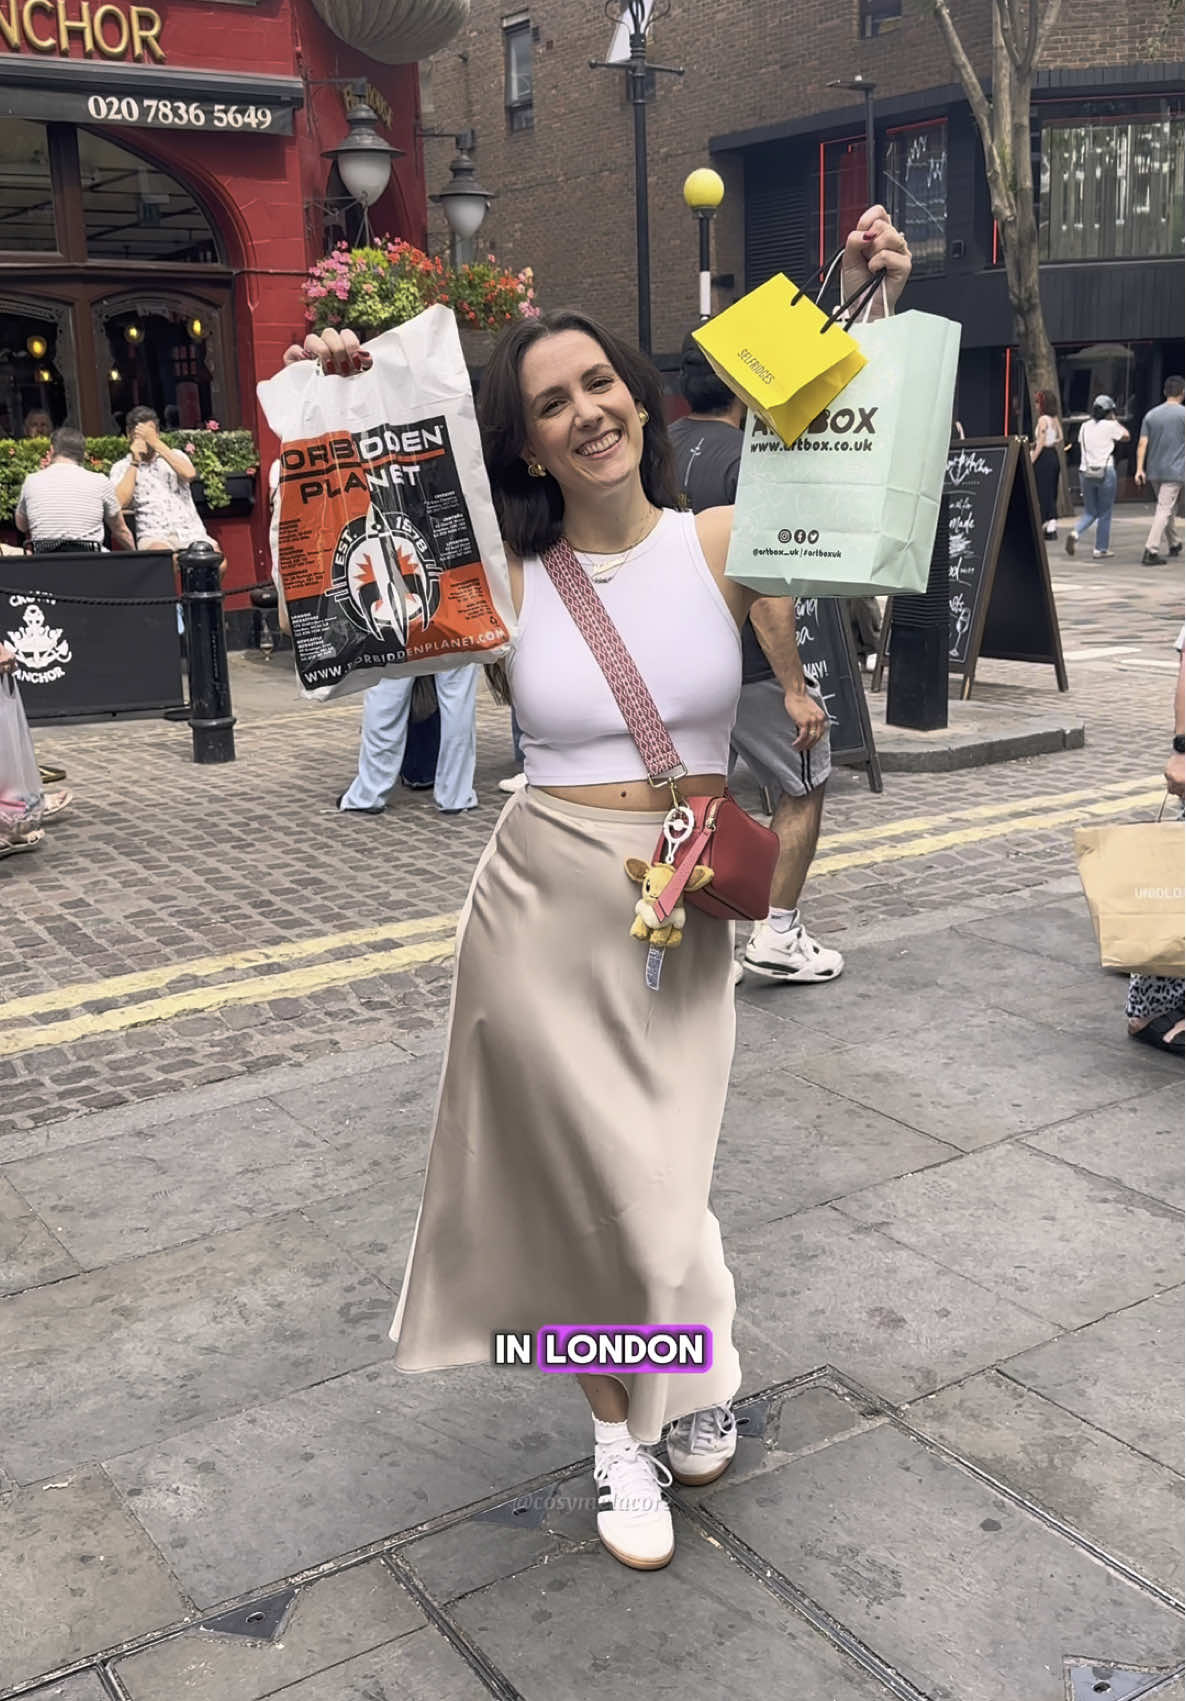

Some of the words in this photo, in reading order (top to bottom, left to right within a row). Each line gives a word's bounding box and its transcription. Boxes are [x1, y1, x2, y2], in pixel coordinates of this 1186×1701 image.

[88, 96, 139, 122] 020
[143, 99, 206, 126] 7836
[213, 104, 272, 129] 5649
[737, 348, 775, 385] SELFRIDGES
[752, 406, 879, 437] ABOX
[281, 425, 443, 470] ORBDDEN
[300, 464, 420, 504] PLANET
[334, 529, 358, 565] EST.
[12, 666, 66, 684] ANCHOR
